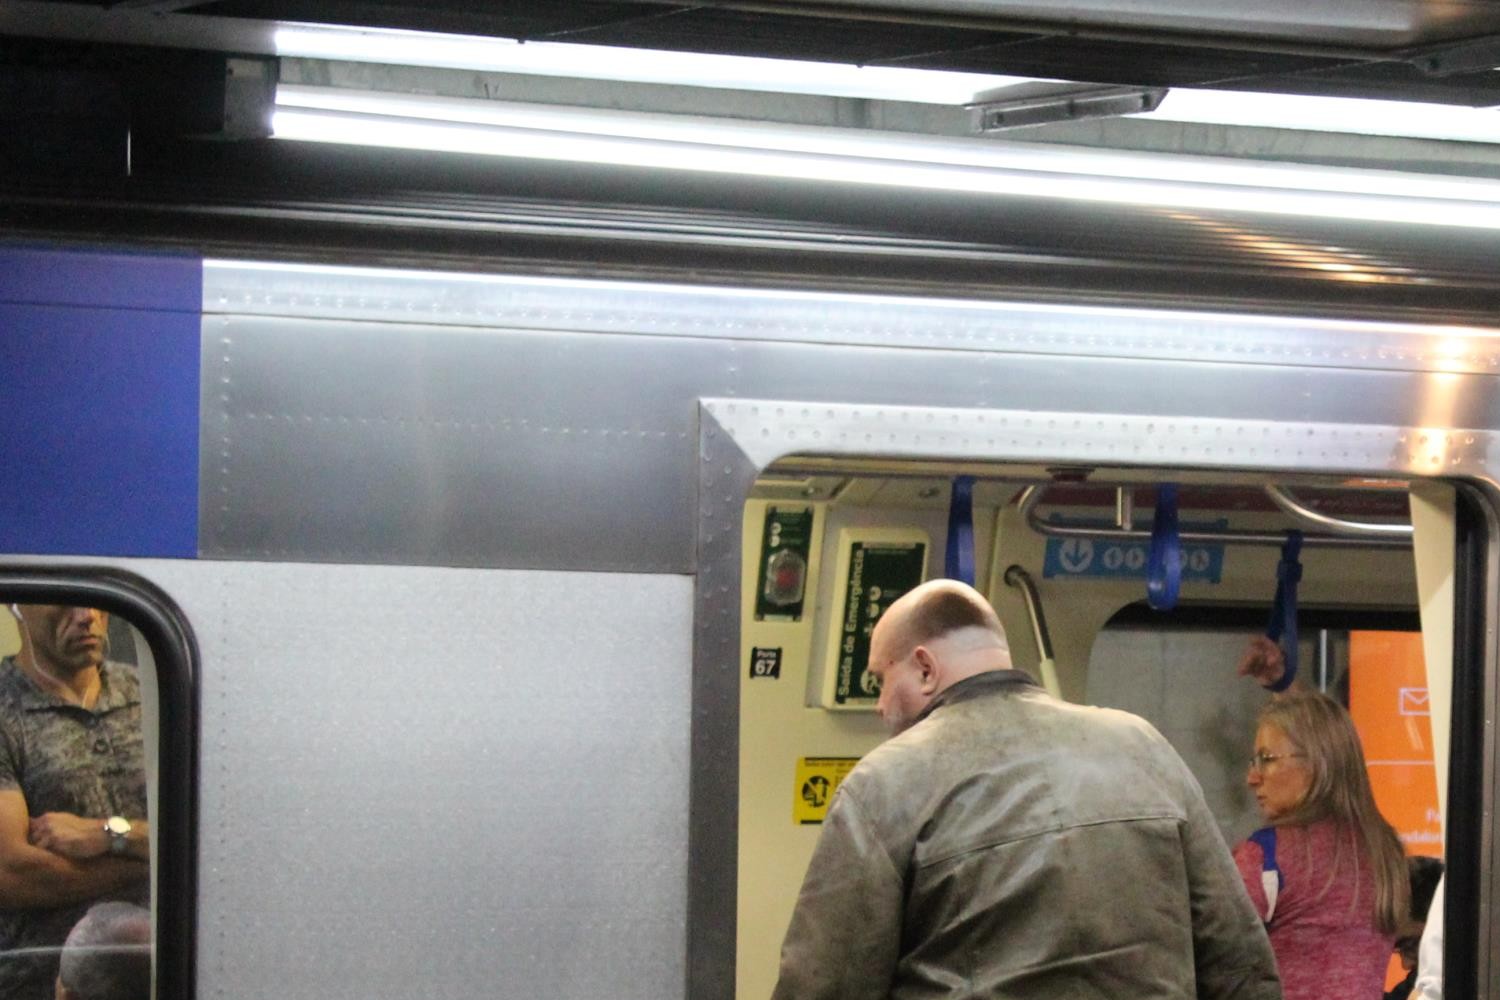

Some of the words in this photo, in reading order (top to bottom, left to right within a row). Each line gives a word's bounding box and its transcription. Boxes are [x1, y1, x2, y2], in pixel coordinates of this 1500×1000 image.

[845, 549, 865, 632] Emergência
[843, 634, 855, 653] de
[755, 660, 777, 675] 67
